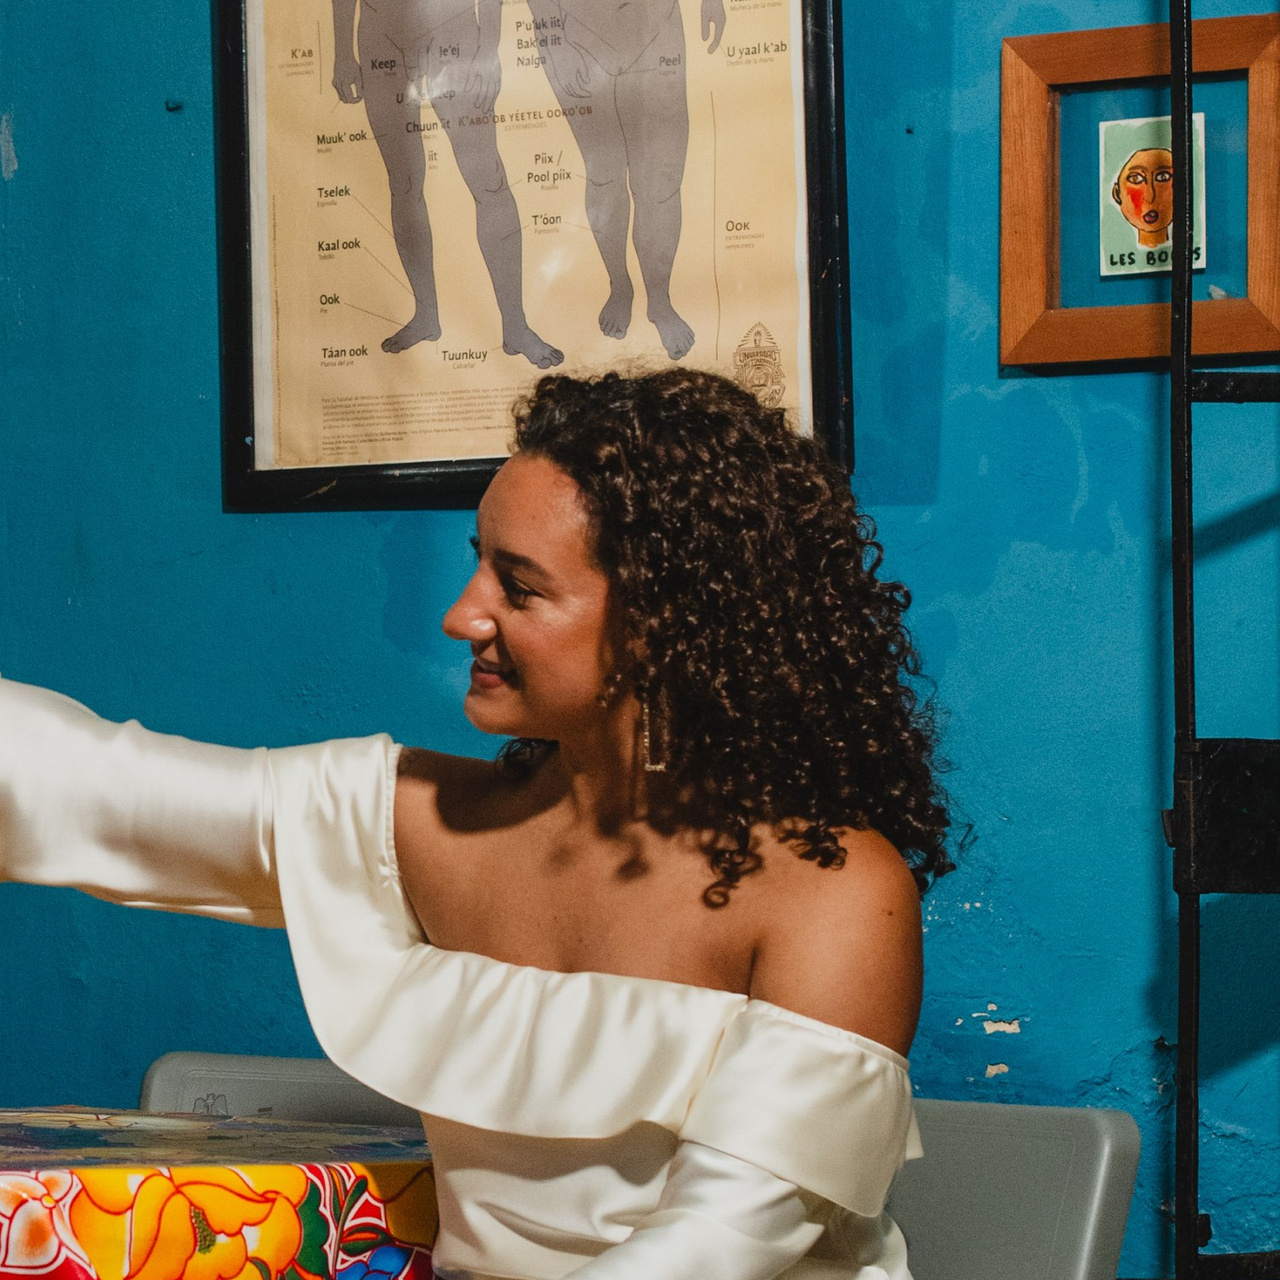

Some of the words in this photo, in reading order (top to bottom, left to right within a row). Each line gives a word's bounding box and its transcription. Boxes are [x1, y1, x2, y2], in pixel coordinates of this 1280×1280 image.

[727, 45, 735, 58] U
[738, 43, 761, 60] yaal
[763, 41, 787, 54] k'ab
[370, 58, 397, 71] Keep
[517, 54, 547, 69] Nalga
[659, 53, 681, 67] Peel
[406, 121, 439, 134] Chuun
[316, 131, 347, 145] Muuk'
[349, 129, 368, 142] ook
[527, 170, 550, 183] Pool
[317, 185, 351, 199] Tselek
[532, 213, 562, 226] T'óon
[317, 238, 340, 252] Kaal
[342, 237, 361, 250] ook
[1109, 252, 1136, 266] LES
[319, 293, 340, 306] Ook
[321, 346, 347, 359] Táan
[349, 344, 368, 357] ook
[442, 349, 488, 364] Tuunkuy
